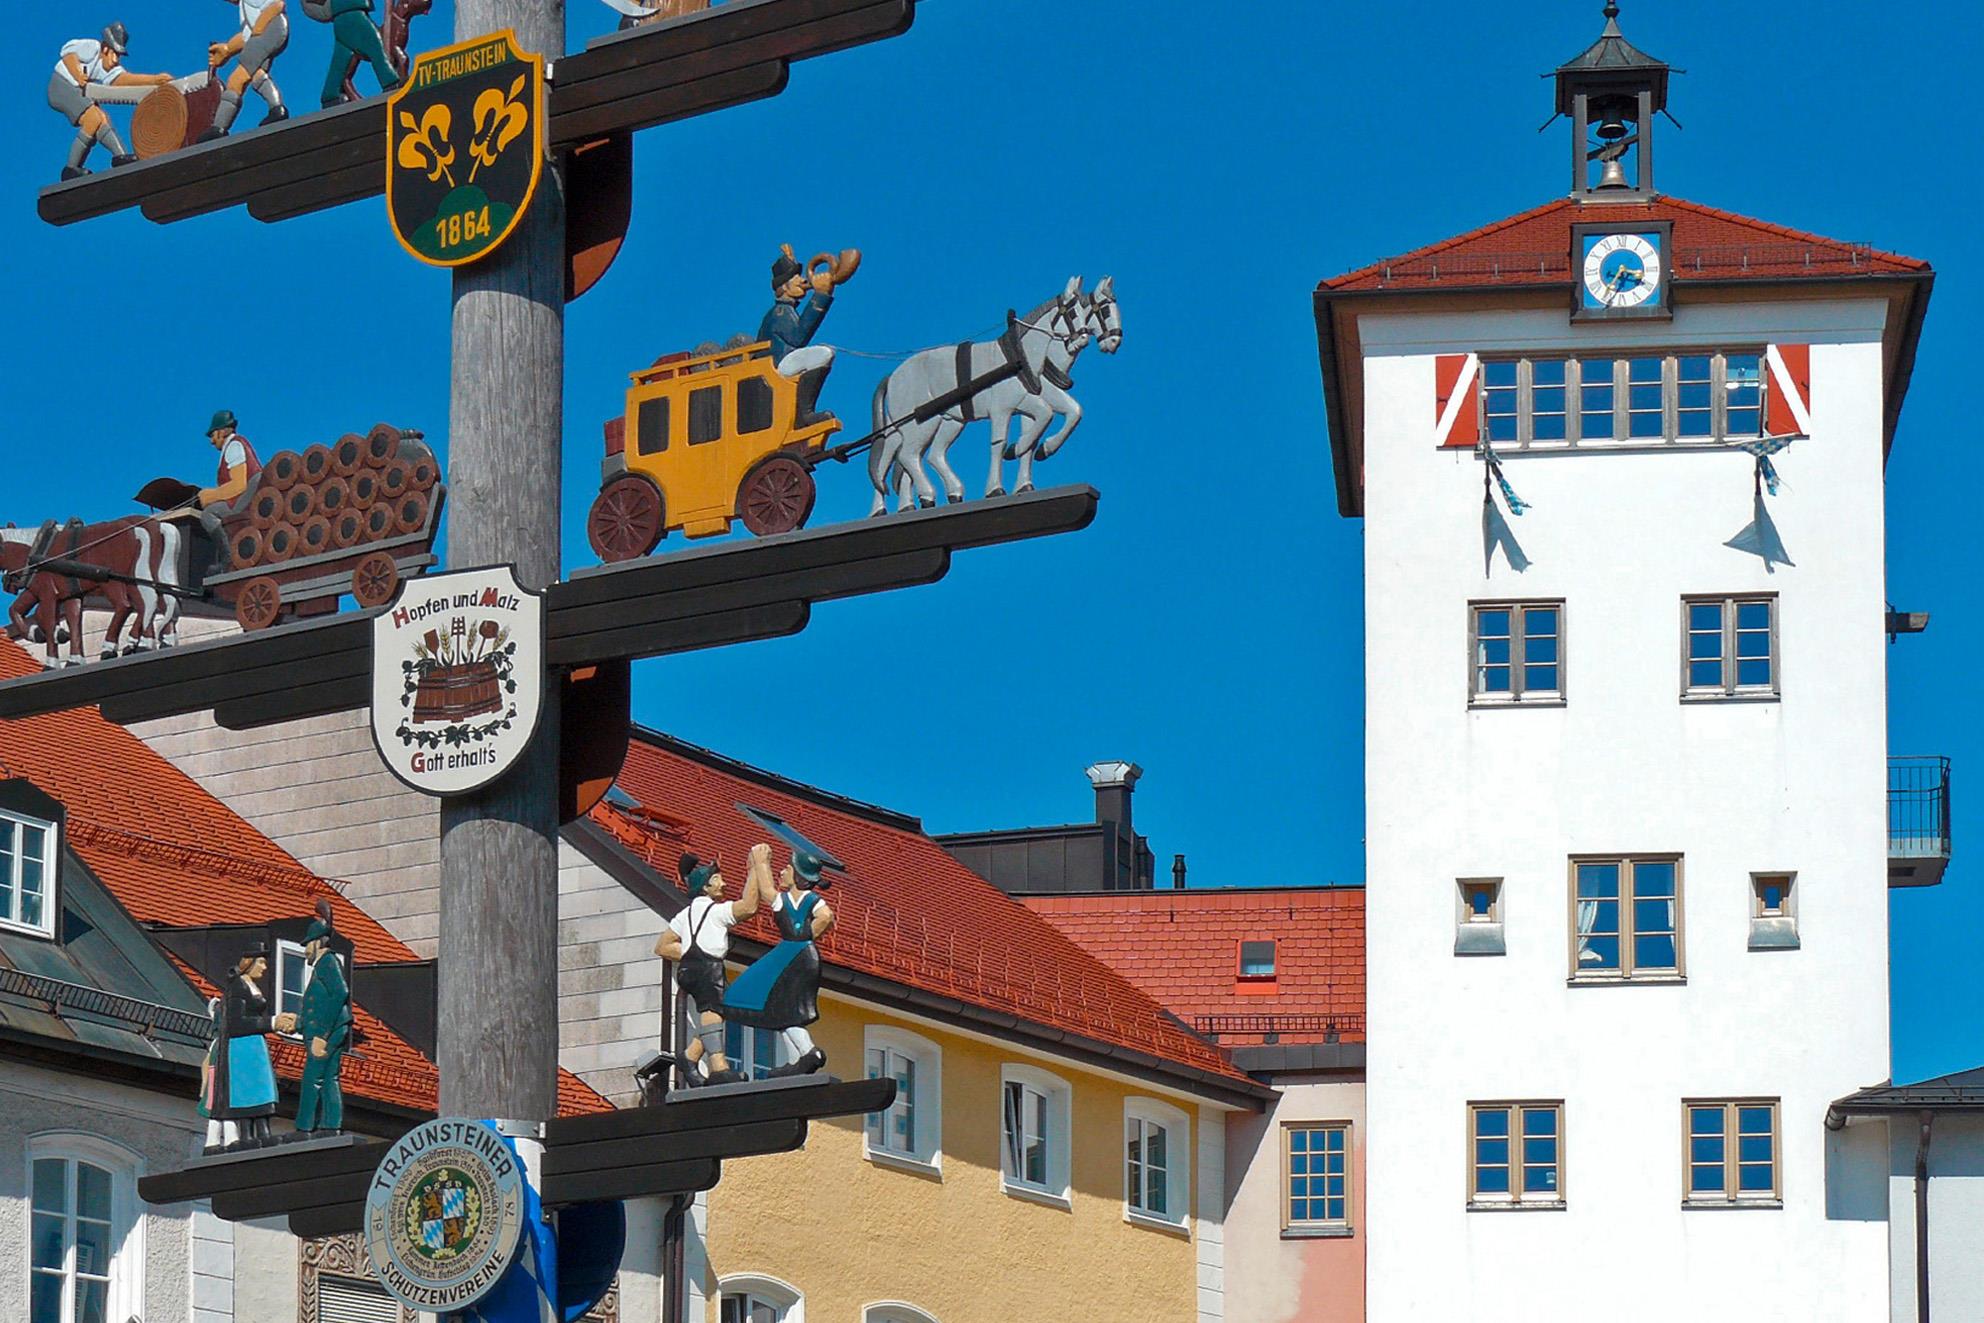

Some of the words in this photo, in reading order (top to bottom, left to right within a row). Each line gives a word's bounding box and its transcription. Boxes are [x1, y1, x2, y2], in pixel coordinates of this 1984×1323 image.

[418, 41, 507, 87] TV-TRAUNSTEIN
[436, 205, 491, 248] 1864
[391, 597, 450, 630] Hopfen
[453, 589, 479, 608] und
[479, 587, 521, 612] Malz
[410, 752, 445, 774] Gott
[374, 1123, 513, 1191] TRAUNSTEINER
